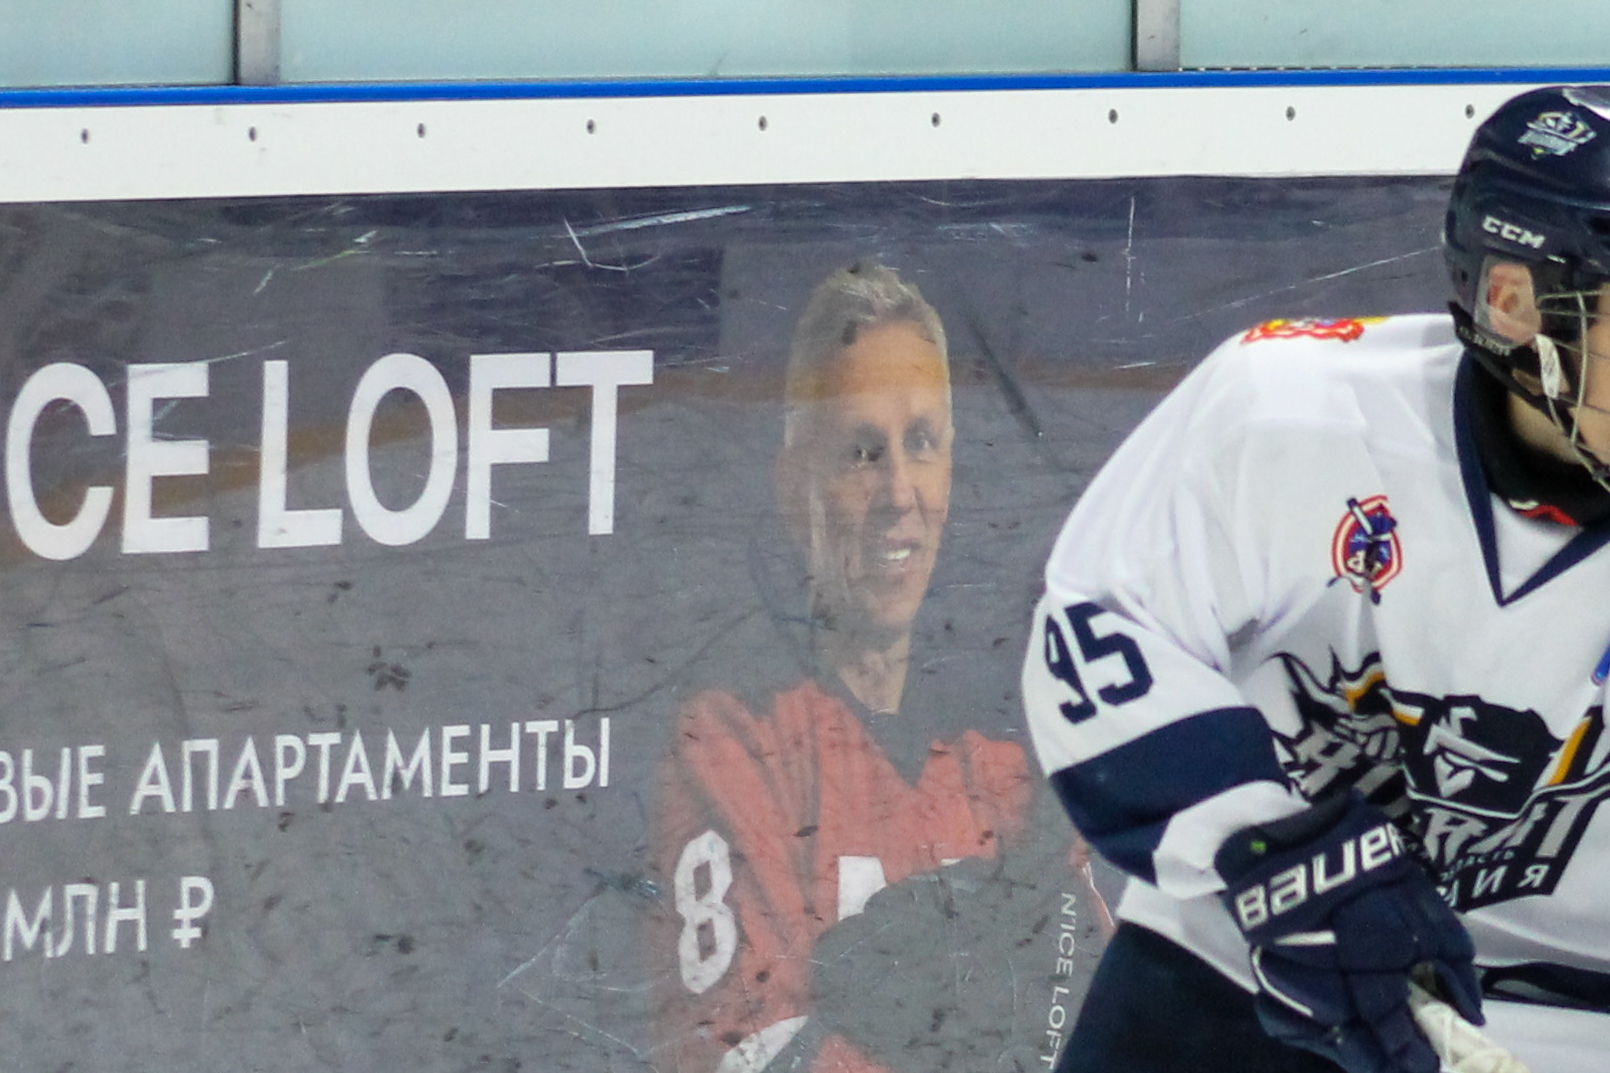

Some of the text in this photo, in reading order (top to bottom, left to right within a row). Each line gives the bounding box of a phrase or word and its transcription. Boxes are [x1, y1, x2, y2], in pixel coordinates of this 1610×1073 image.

[1482, 215, 1545, 249] CCM
[5, 350, 655, 561] CE LOFT
[1045, 601, 1154, 725] 95
[129, 718, 610, 815] АПАРТАМЕНТЫ
[3, 875, 214, 962] МЛН ₽
[674, 830, 737, 994] 8
[1040, 892, 1077, 1070] NICE LOFT
